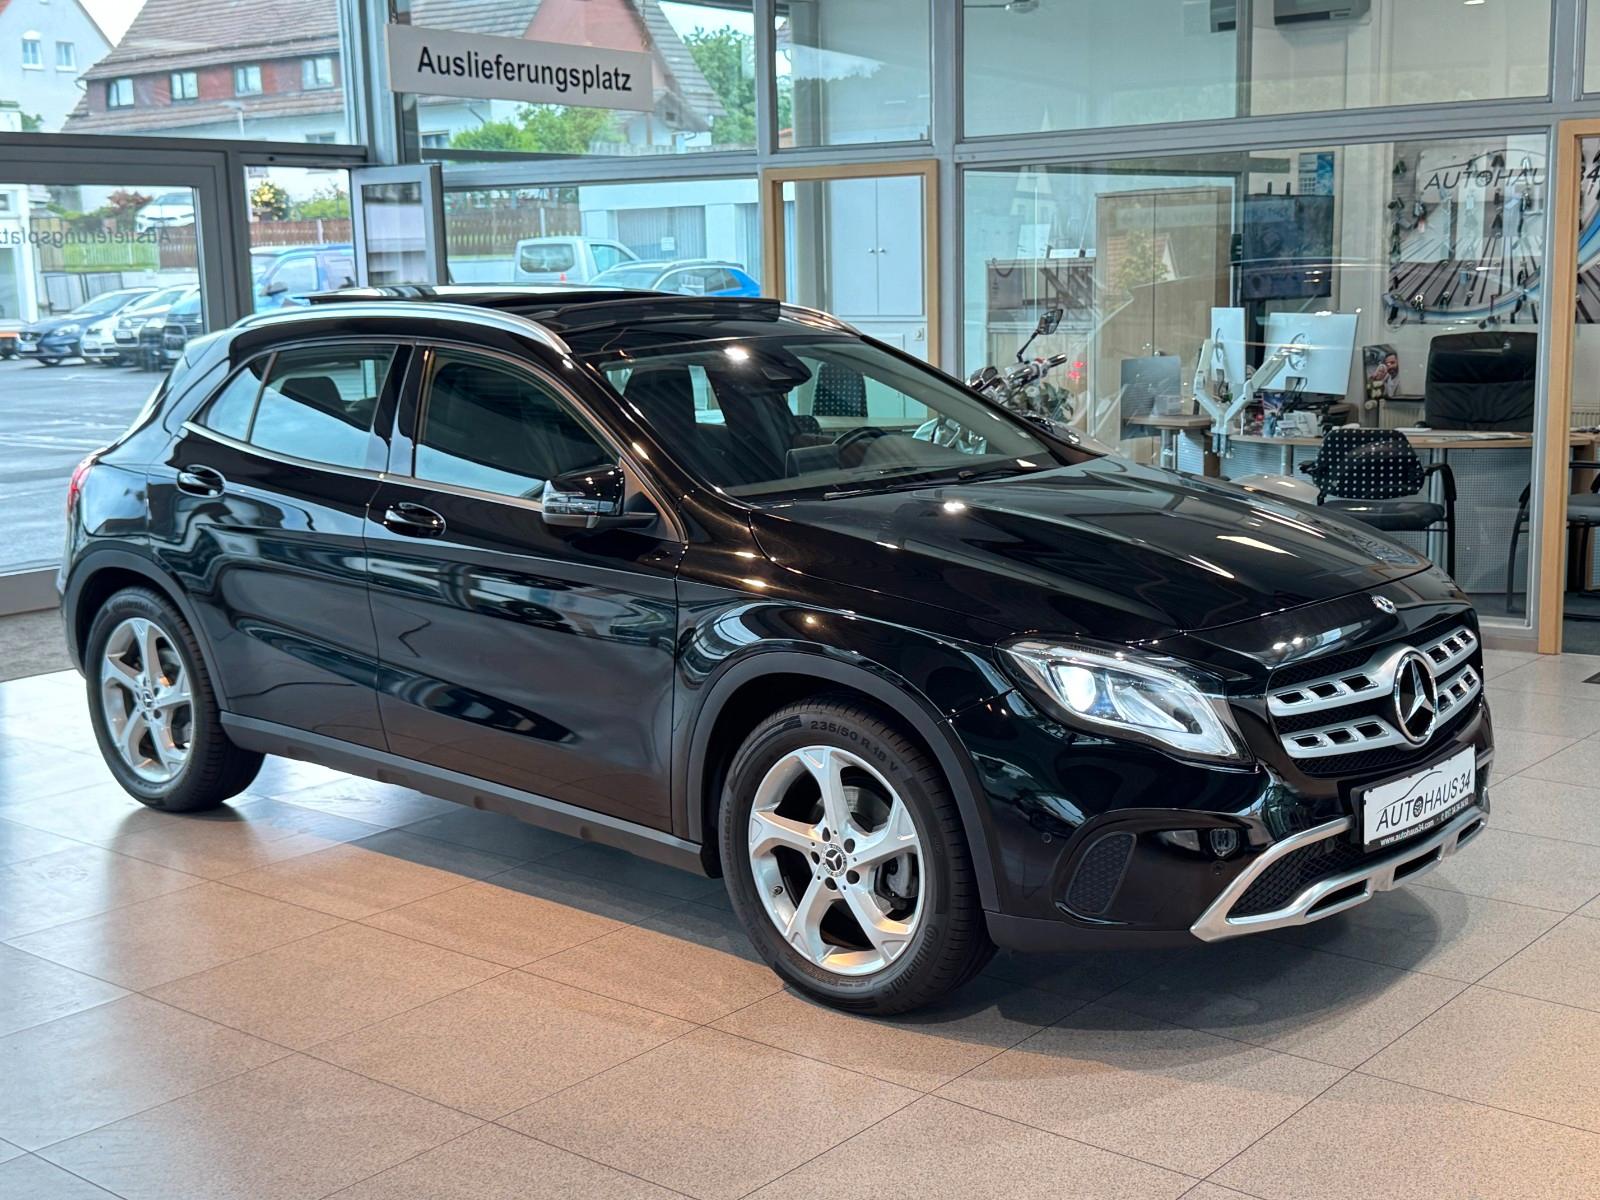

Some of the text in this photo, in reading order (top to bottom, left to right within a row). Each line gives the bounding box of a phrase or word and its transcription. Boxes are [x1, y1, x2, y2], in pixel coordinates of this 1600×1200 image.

[417, 46, 632, 94] Auslieferungsplatz
[810, 720, 858, 741] 235/50
[861, 736, 870, 749] R
[1376, 777, 1458, 832] AUTOHAUS
[1460, 769, 1471, 794] 34
